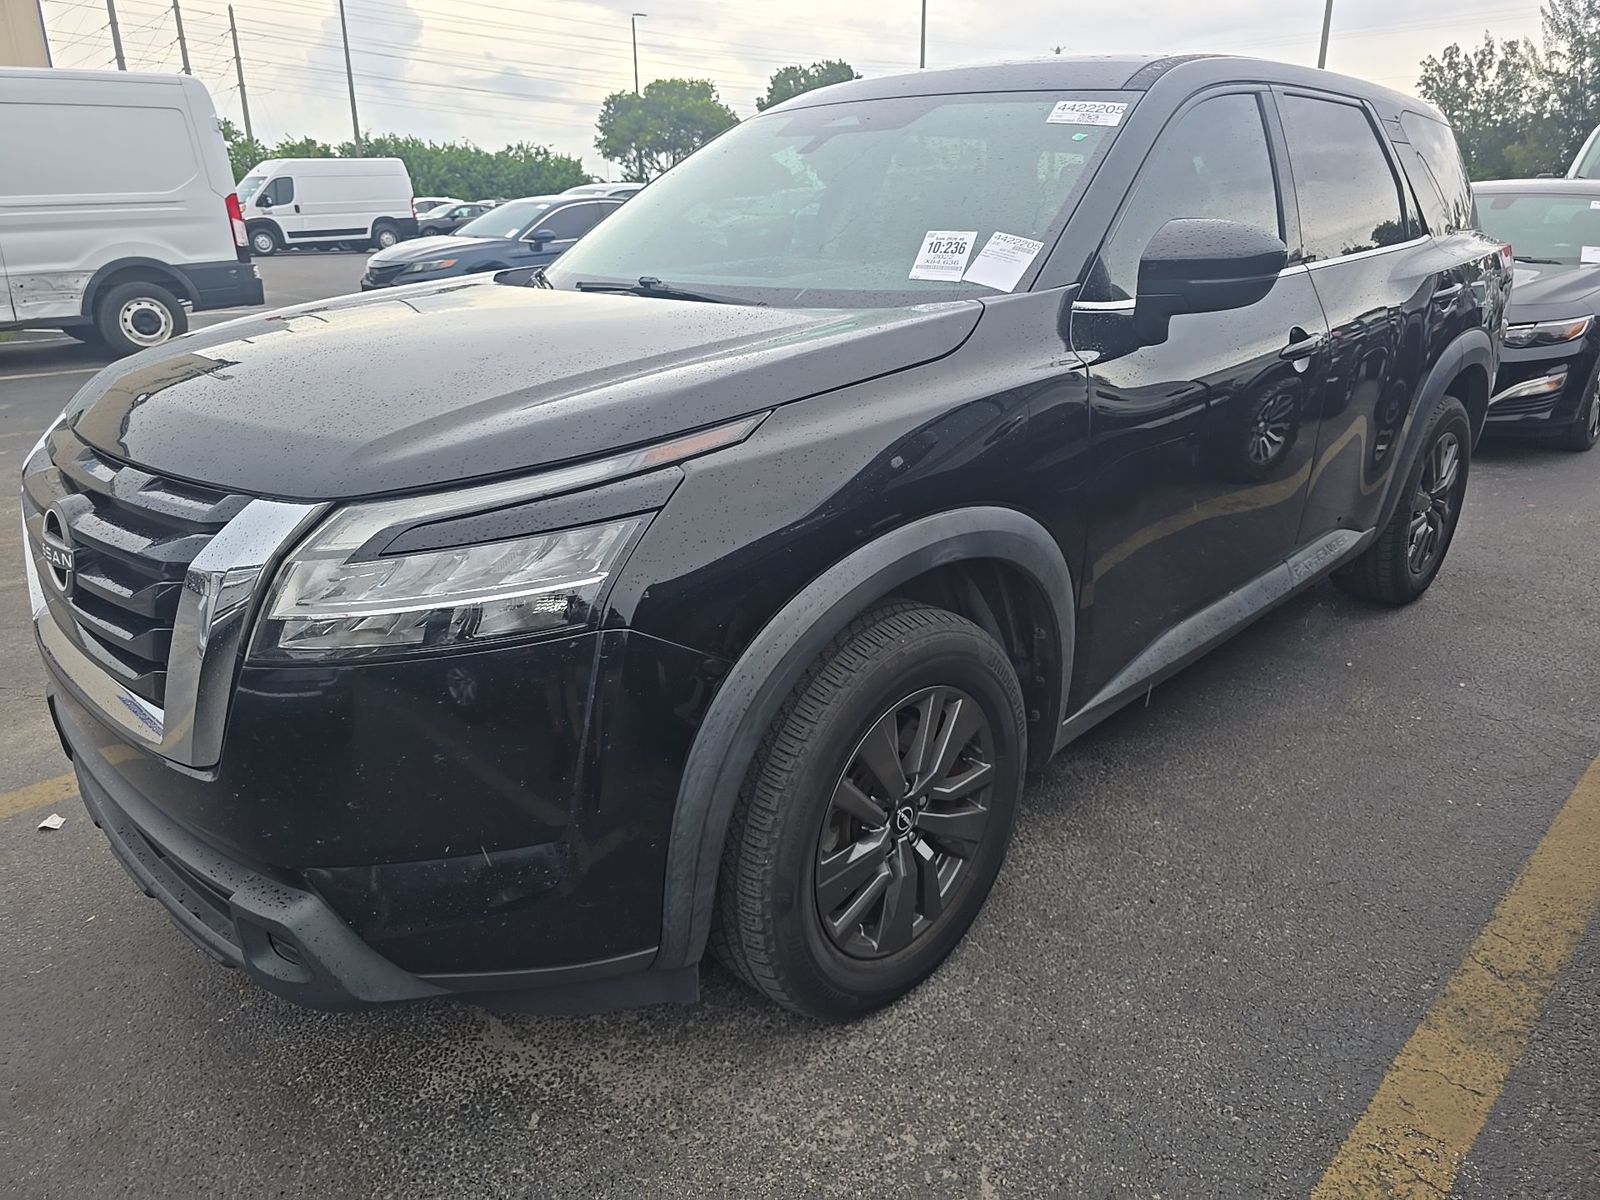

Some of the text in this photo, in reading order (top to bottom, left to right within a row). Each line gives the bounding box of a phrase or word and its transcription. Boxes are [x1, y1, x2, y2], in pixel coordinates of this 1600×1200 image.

[1058, 103, 1125, 114] 4422205
[928, 241, 967, 255] 10:236
[994, 234, 1041, 251] 4422205
